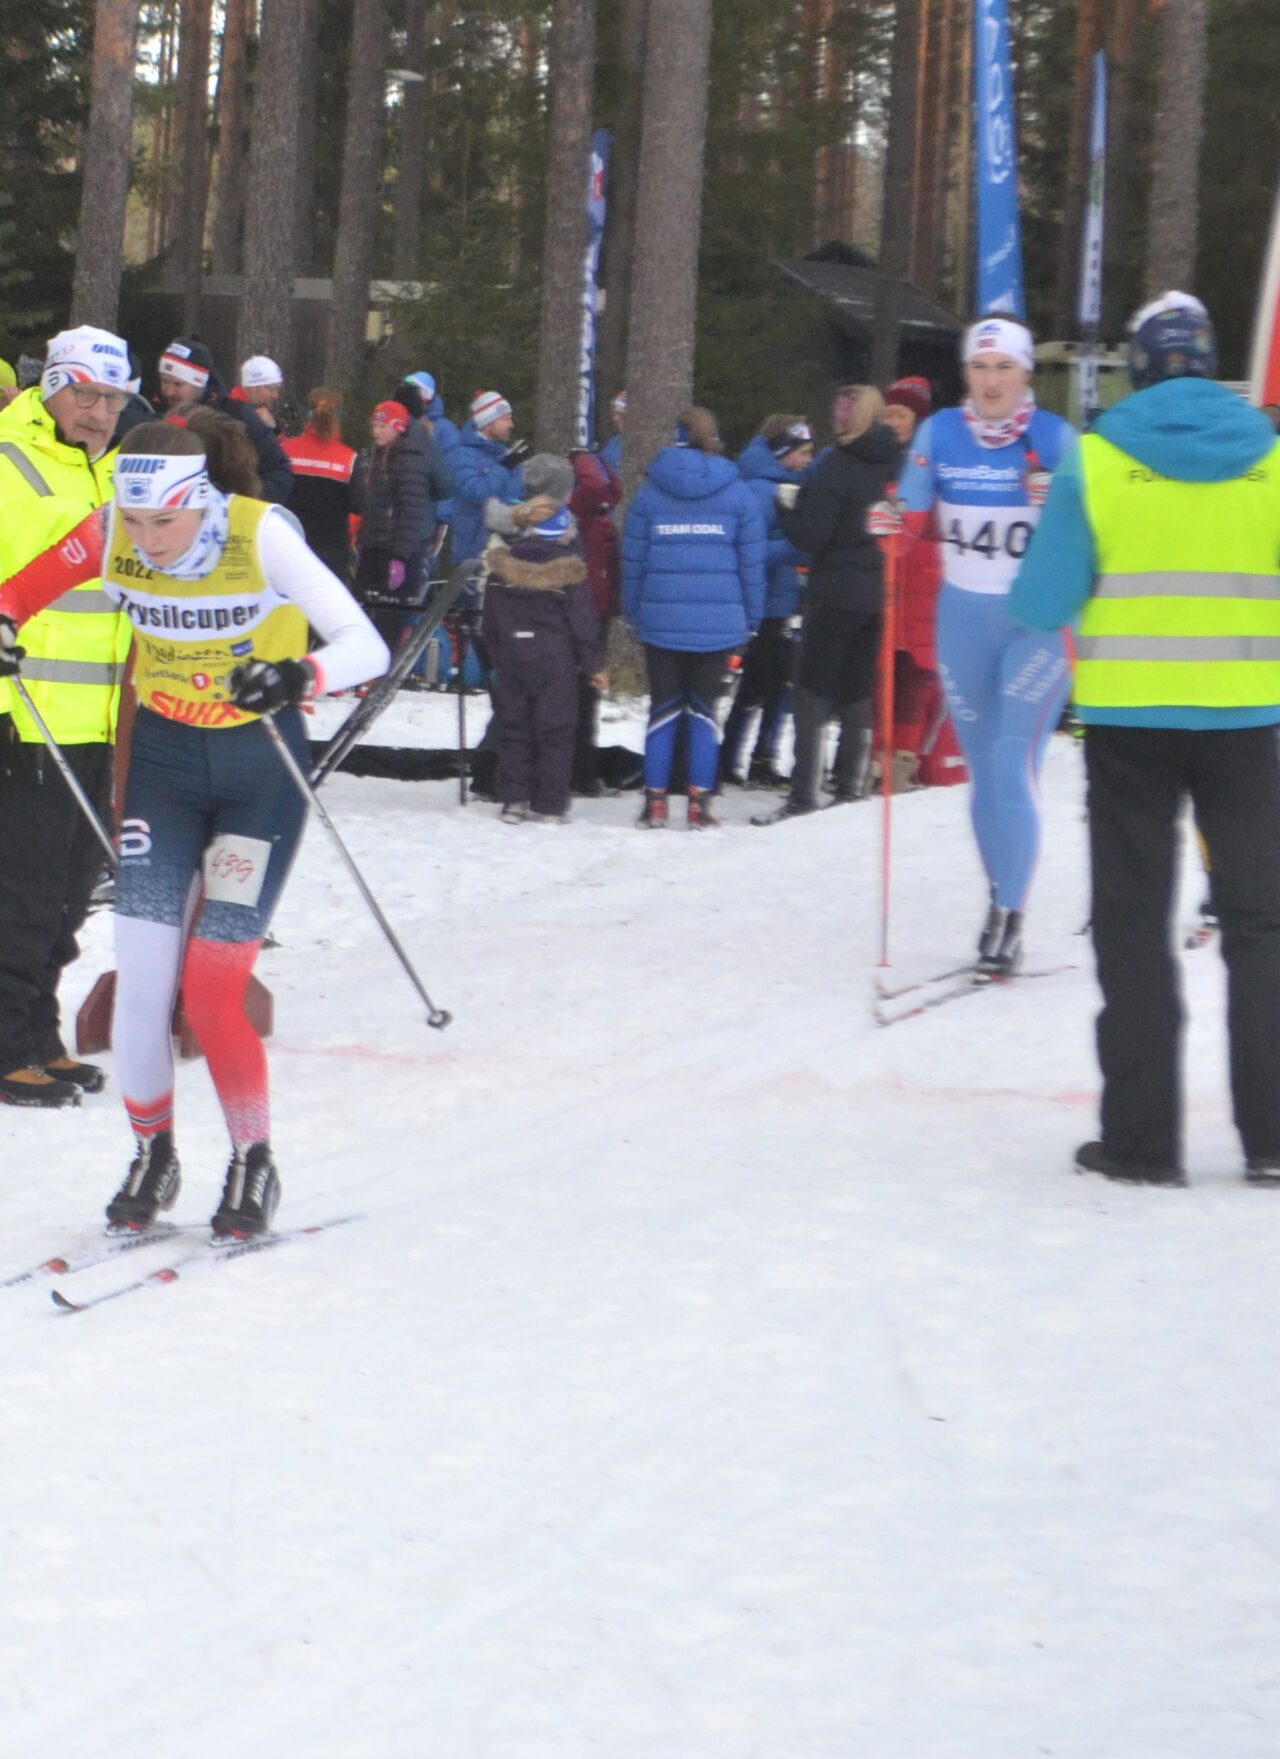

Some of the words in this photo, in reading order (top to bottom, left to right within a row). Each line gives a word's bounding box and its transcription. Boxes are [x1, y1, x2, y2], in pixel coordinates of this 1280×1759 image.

[655, 524, 691, 535] TEAM
[692, 523, 726, 535] ODAL
[114, 555, 154, 581] 2022
